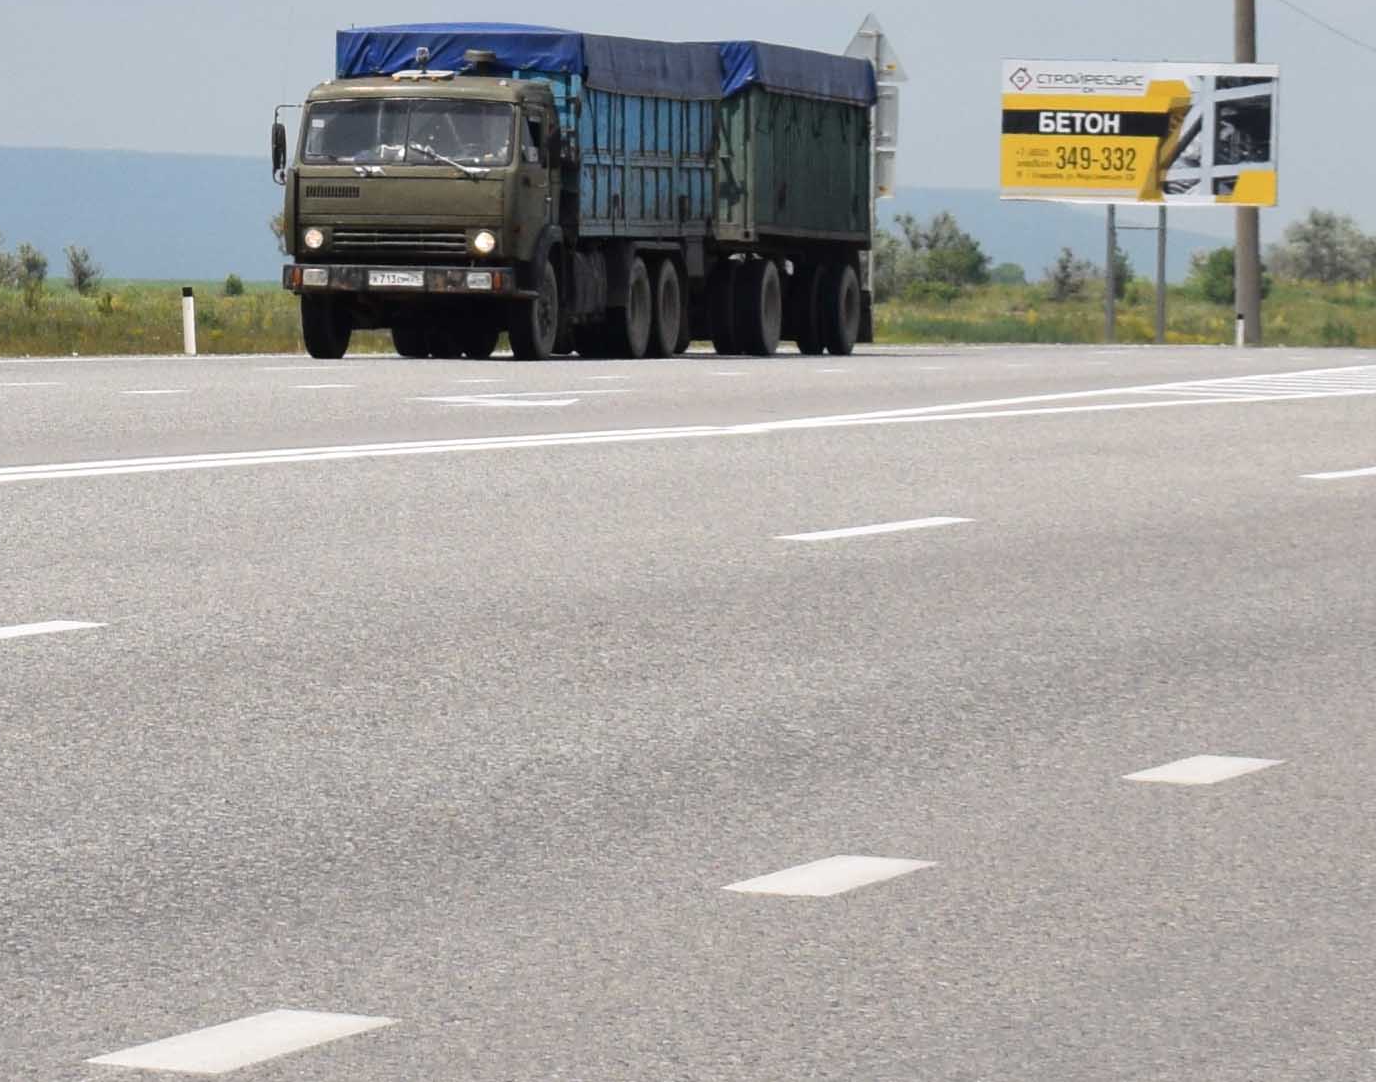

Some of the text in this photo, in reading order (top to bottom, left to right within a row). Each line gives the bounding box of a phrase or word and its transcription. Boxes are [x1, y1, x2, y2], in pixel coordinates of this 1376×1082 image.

[1036, 72, 1145, 86] СТРОЙРЕСУРС
[1038, 111, 1121, 134] БЕТОН
[1055, 146, 1137, 172] 349-332
